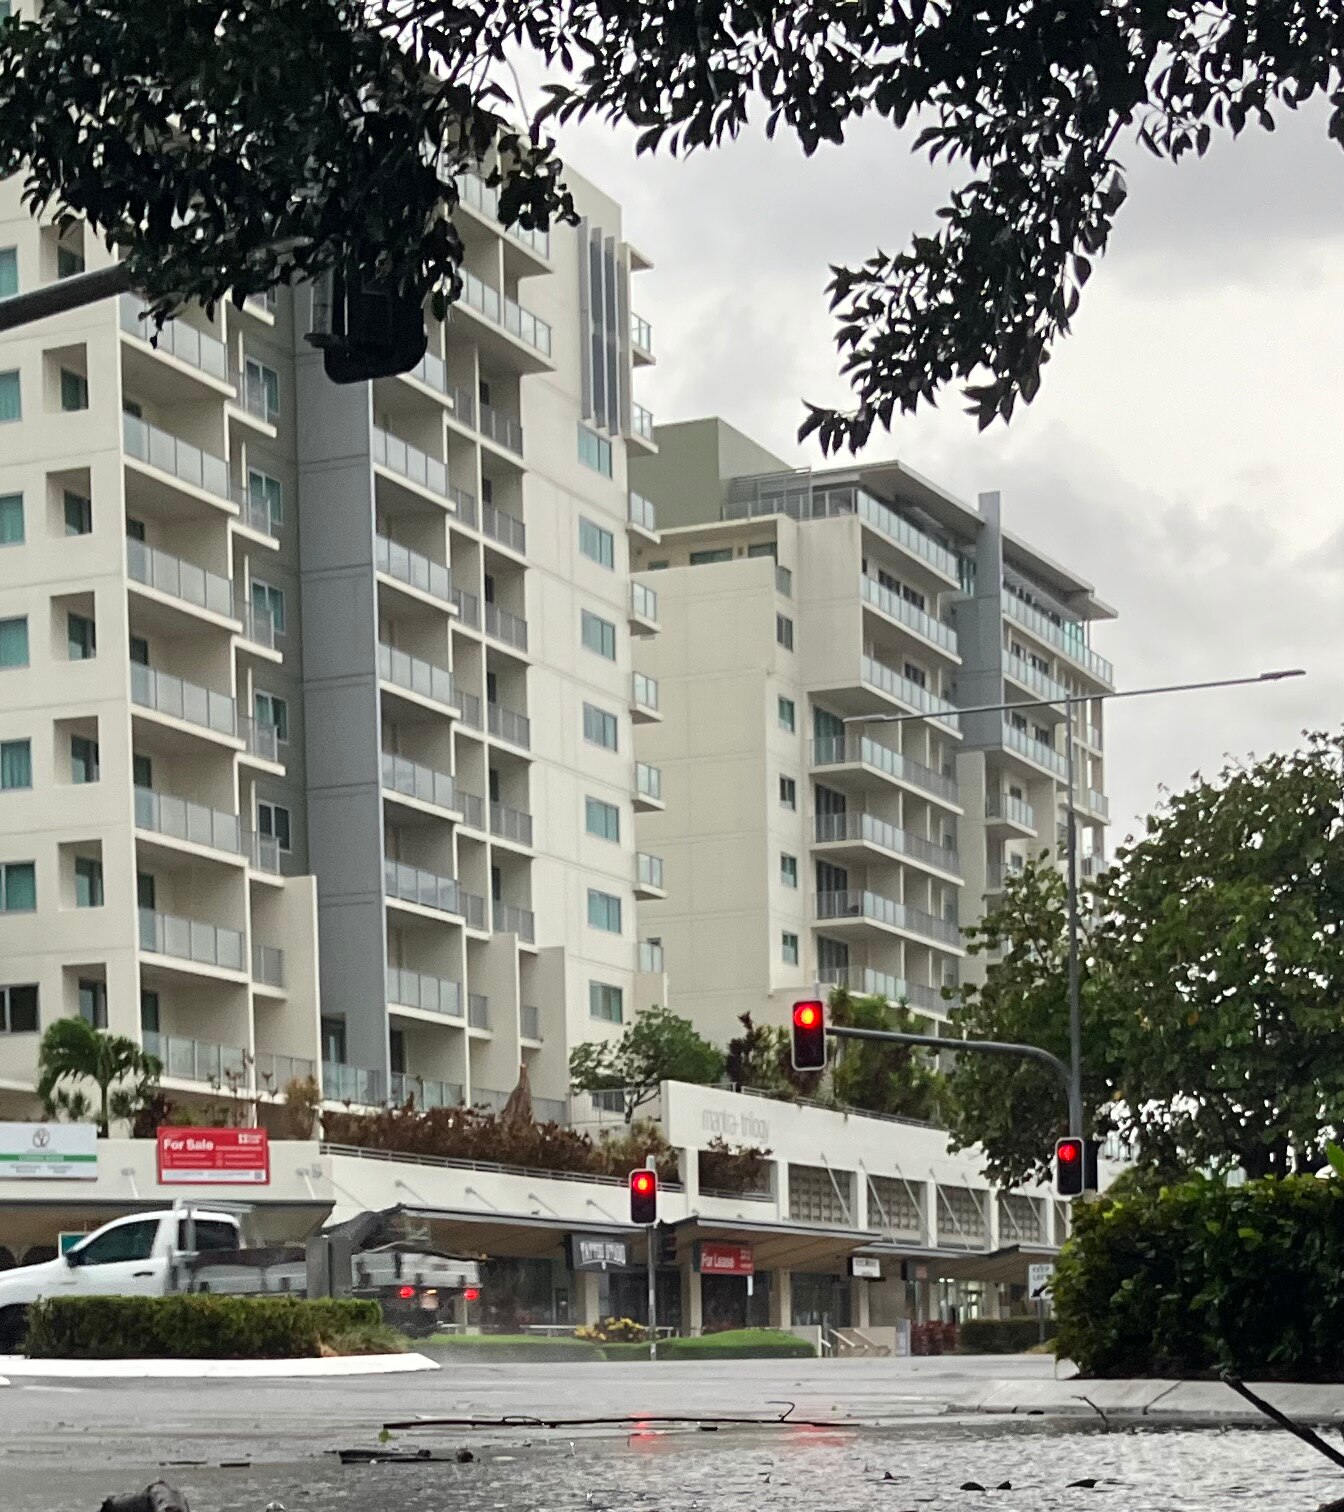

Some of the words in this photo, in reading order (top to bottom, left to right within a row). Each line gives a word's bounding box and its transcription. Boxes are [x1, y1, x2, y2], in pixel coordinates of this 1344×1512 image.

[163, 1138, 184, 1151] For
[186, 1138, 214, 1152] Sale
[701, 1252, 713, 1267] For
[714, 1253, 735, 1269] Lease
